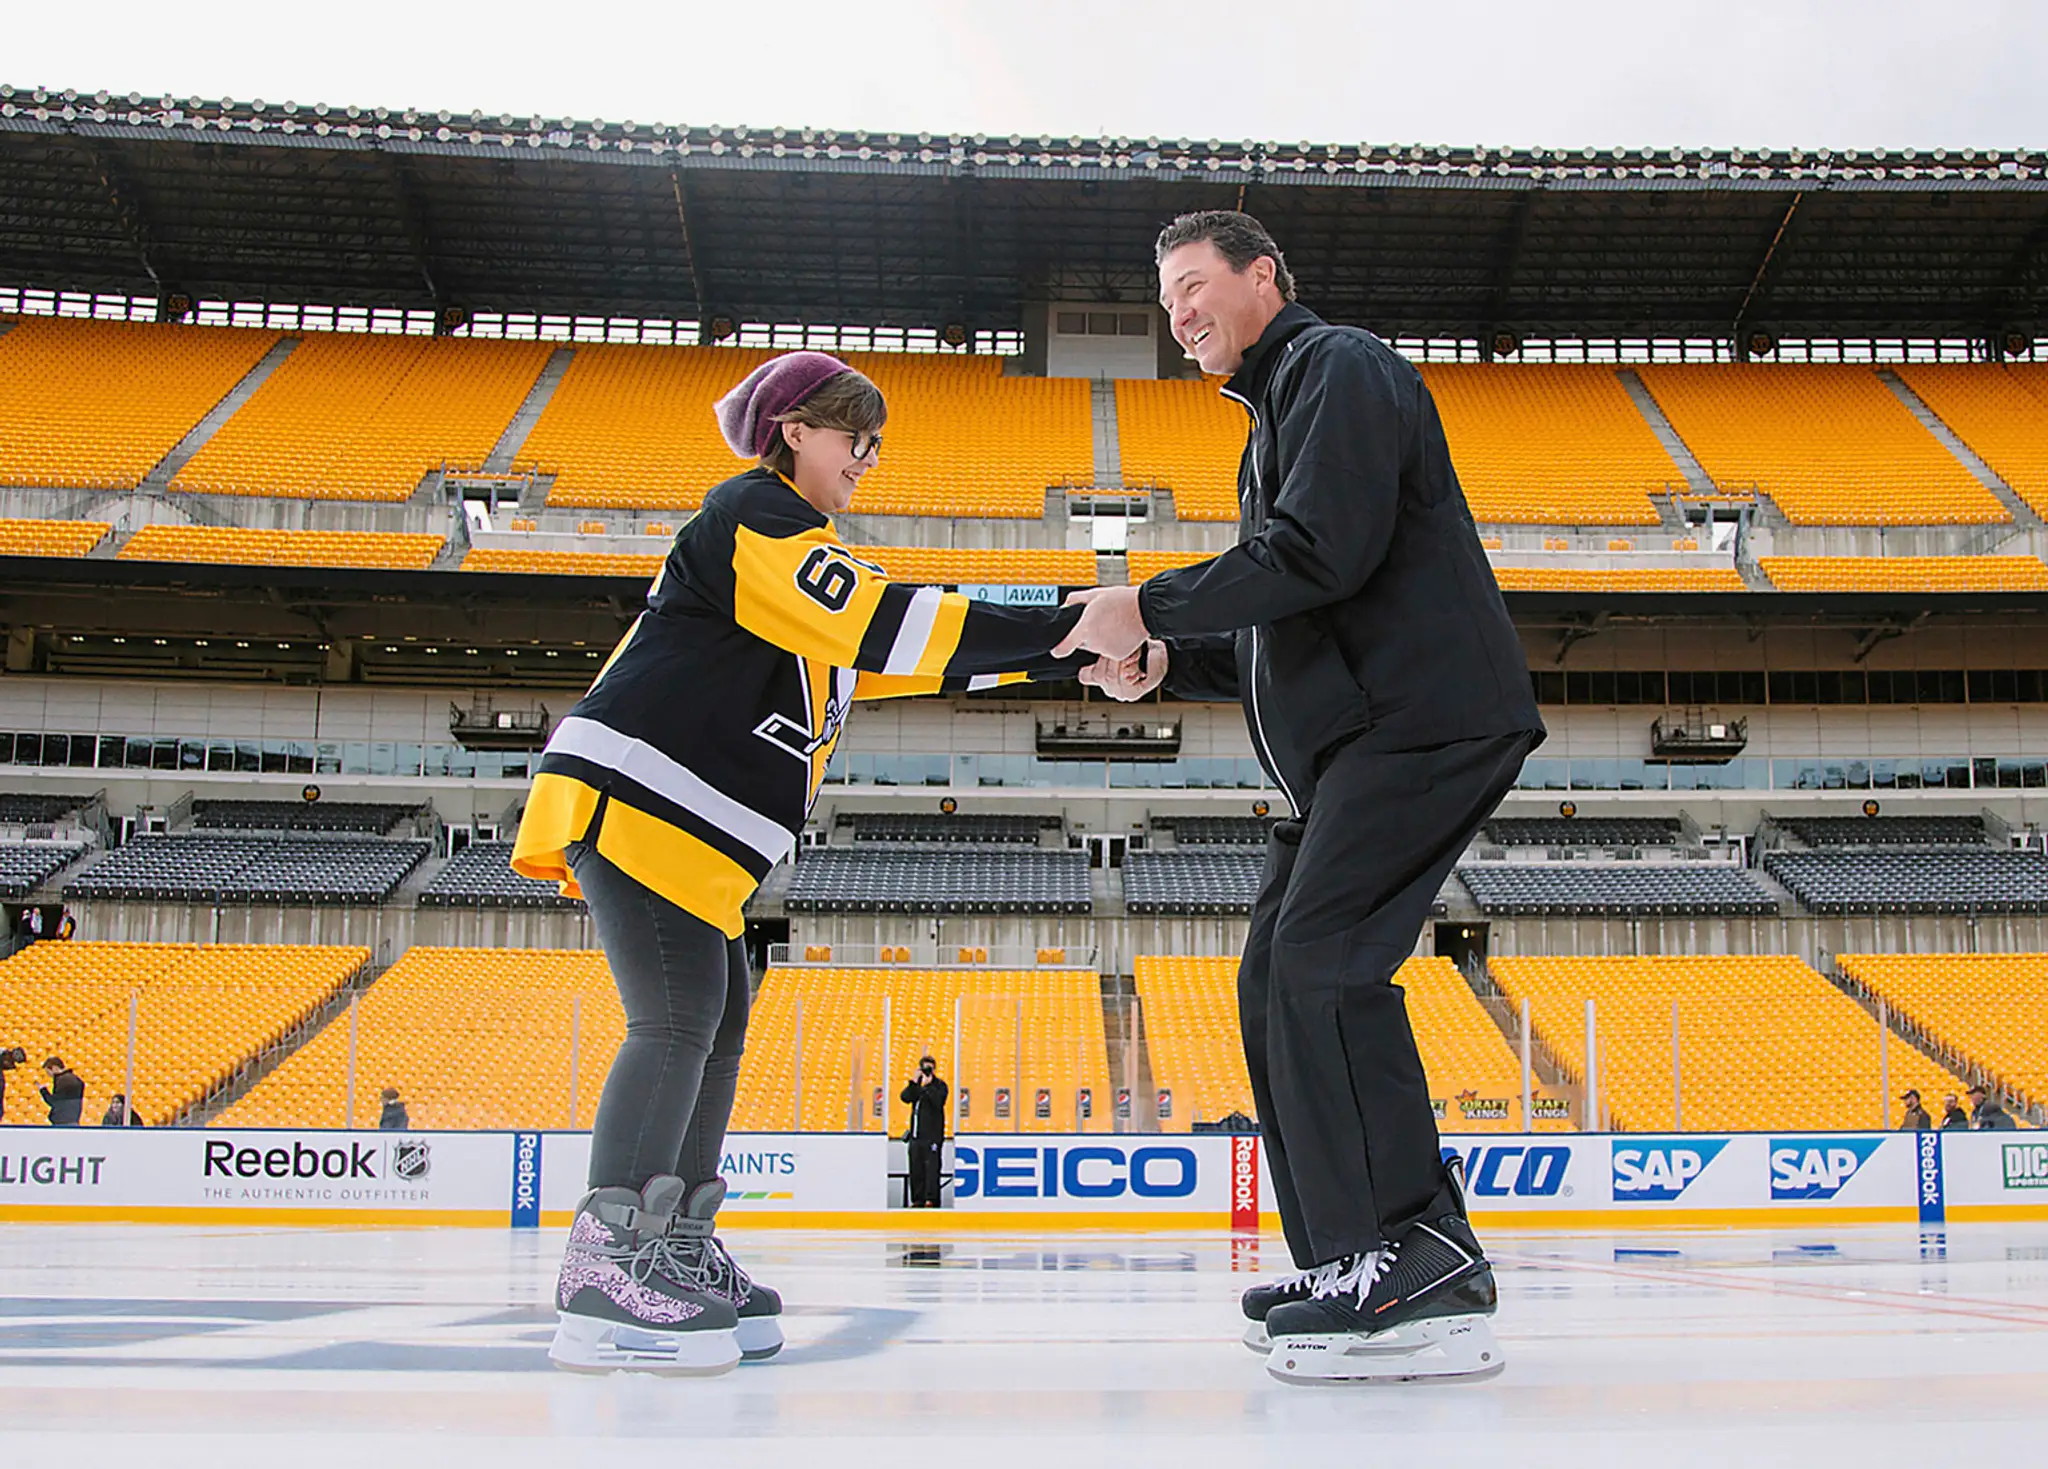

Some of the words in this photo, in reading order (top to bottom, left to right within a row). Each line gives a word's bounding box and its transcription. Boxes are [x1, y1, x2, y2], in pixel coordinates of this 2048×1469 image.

[793, 544, 887, 614] 6
[1008, 588, 1055, 602] AWAY
[1466, 1109, 1508, 1118] KINGS
[0, 1156, 107, 1184] LIGHT
[204, 1140, 377, 1178] Reebok
[518, 1134, 537, 1210] Reebok
[718, 1153, 796, 1175] AINTS
[1236, 1137, 1255, 1211] Reebok
[1613, 1149, 1703, 1191] SAP
[1771, 1149, 1858, 1189] SAP
[1921, 1133, 1939, 1205] Reebok
[2005, 1147, 2048, 1178] DIC
[203, 1187, 233, 1199] THE
[240, 1188, 332, 1200] AUTHENTIC
[340, 1189, 429, 1201] OUTFITTER
[1287, 1343, 1328, 1351] EASTON
